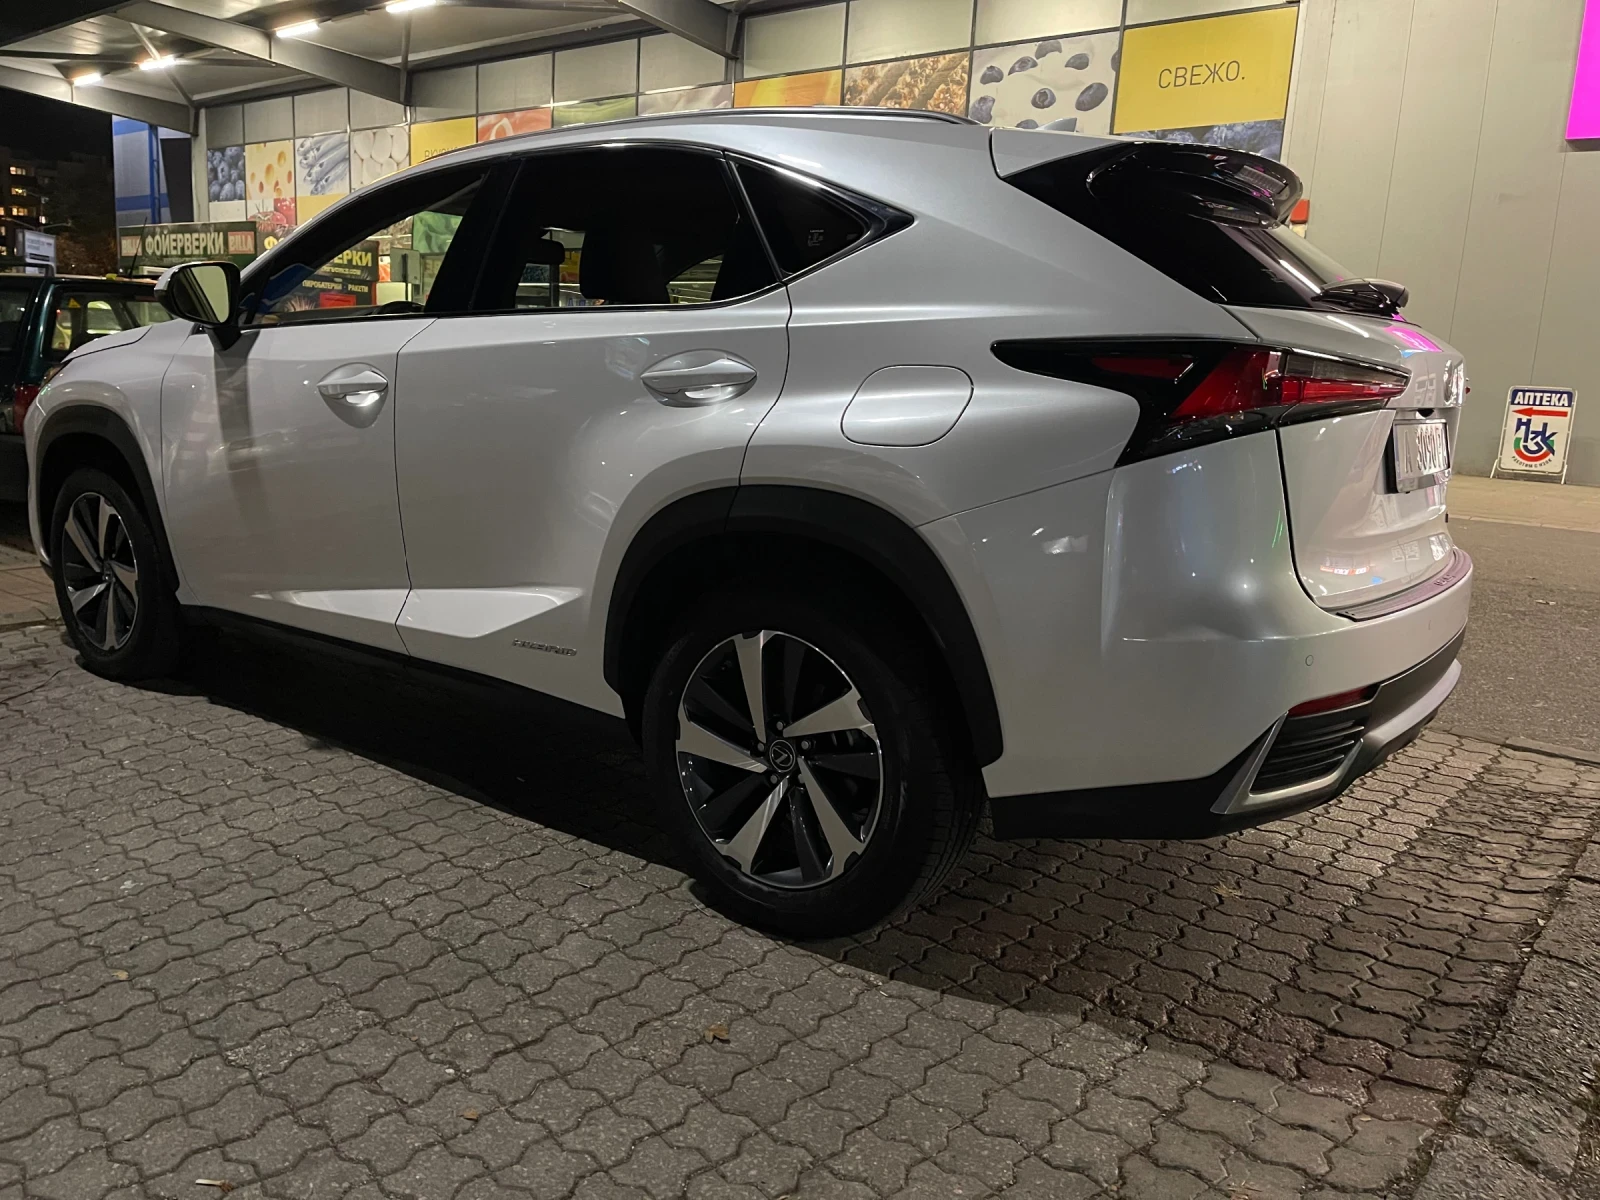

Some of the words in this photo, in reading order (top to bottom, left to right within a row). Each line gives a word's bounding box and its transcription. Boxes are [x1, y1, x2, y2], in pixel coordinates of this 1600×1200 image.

[1158, 60, 1245, 89] СВЕЖО.
[145, 230, 224, 256] ФОЙЕРВЕРКИ
[229, 235, 255, 253] BILLA
[1513, 391, 1569, 407] АПТЕКА
